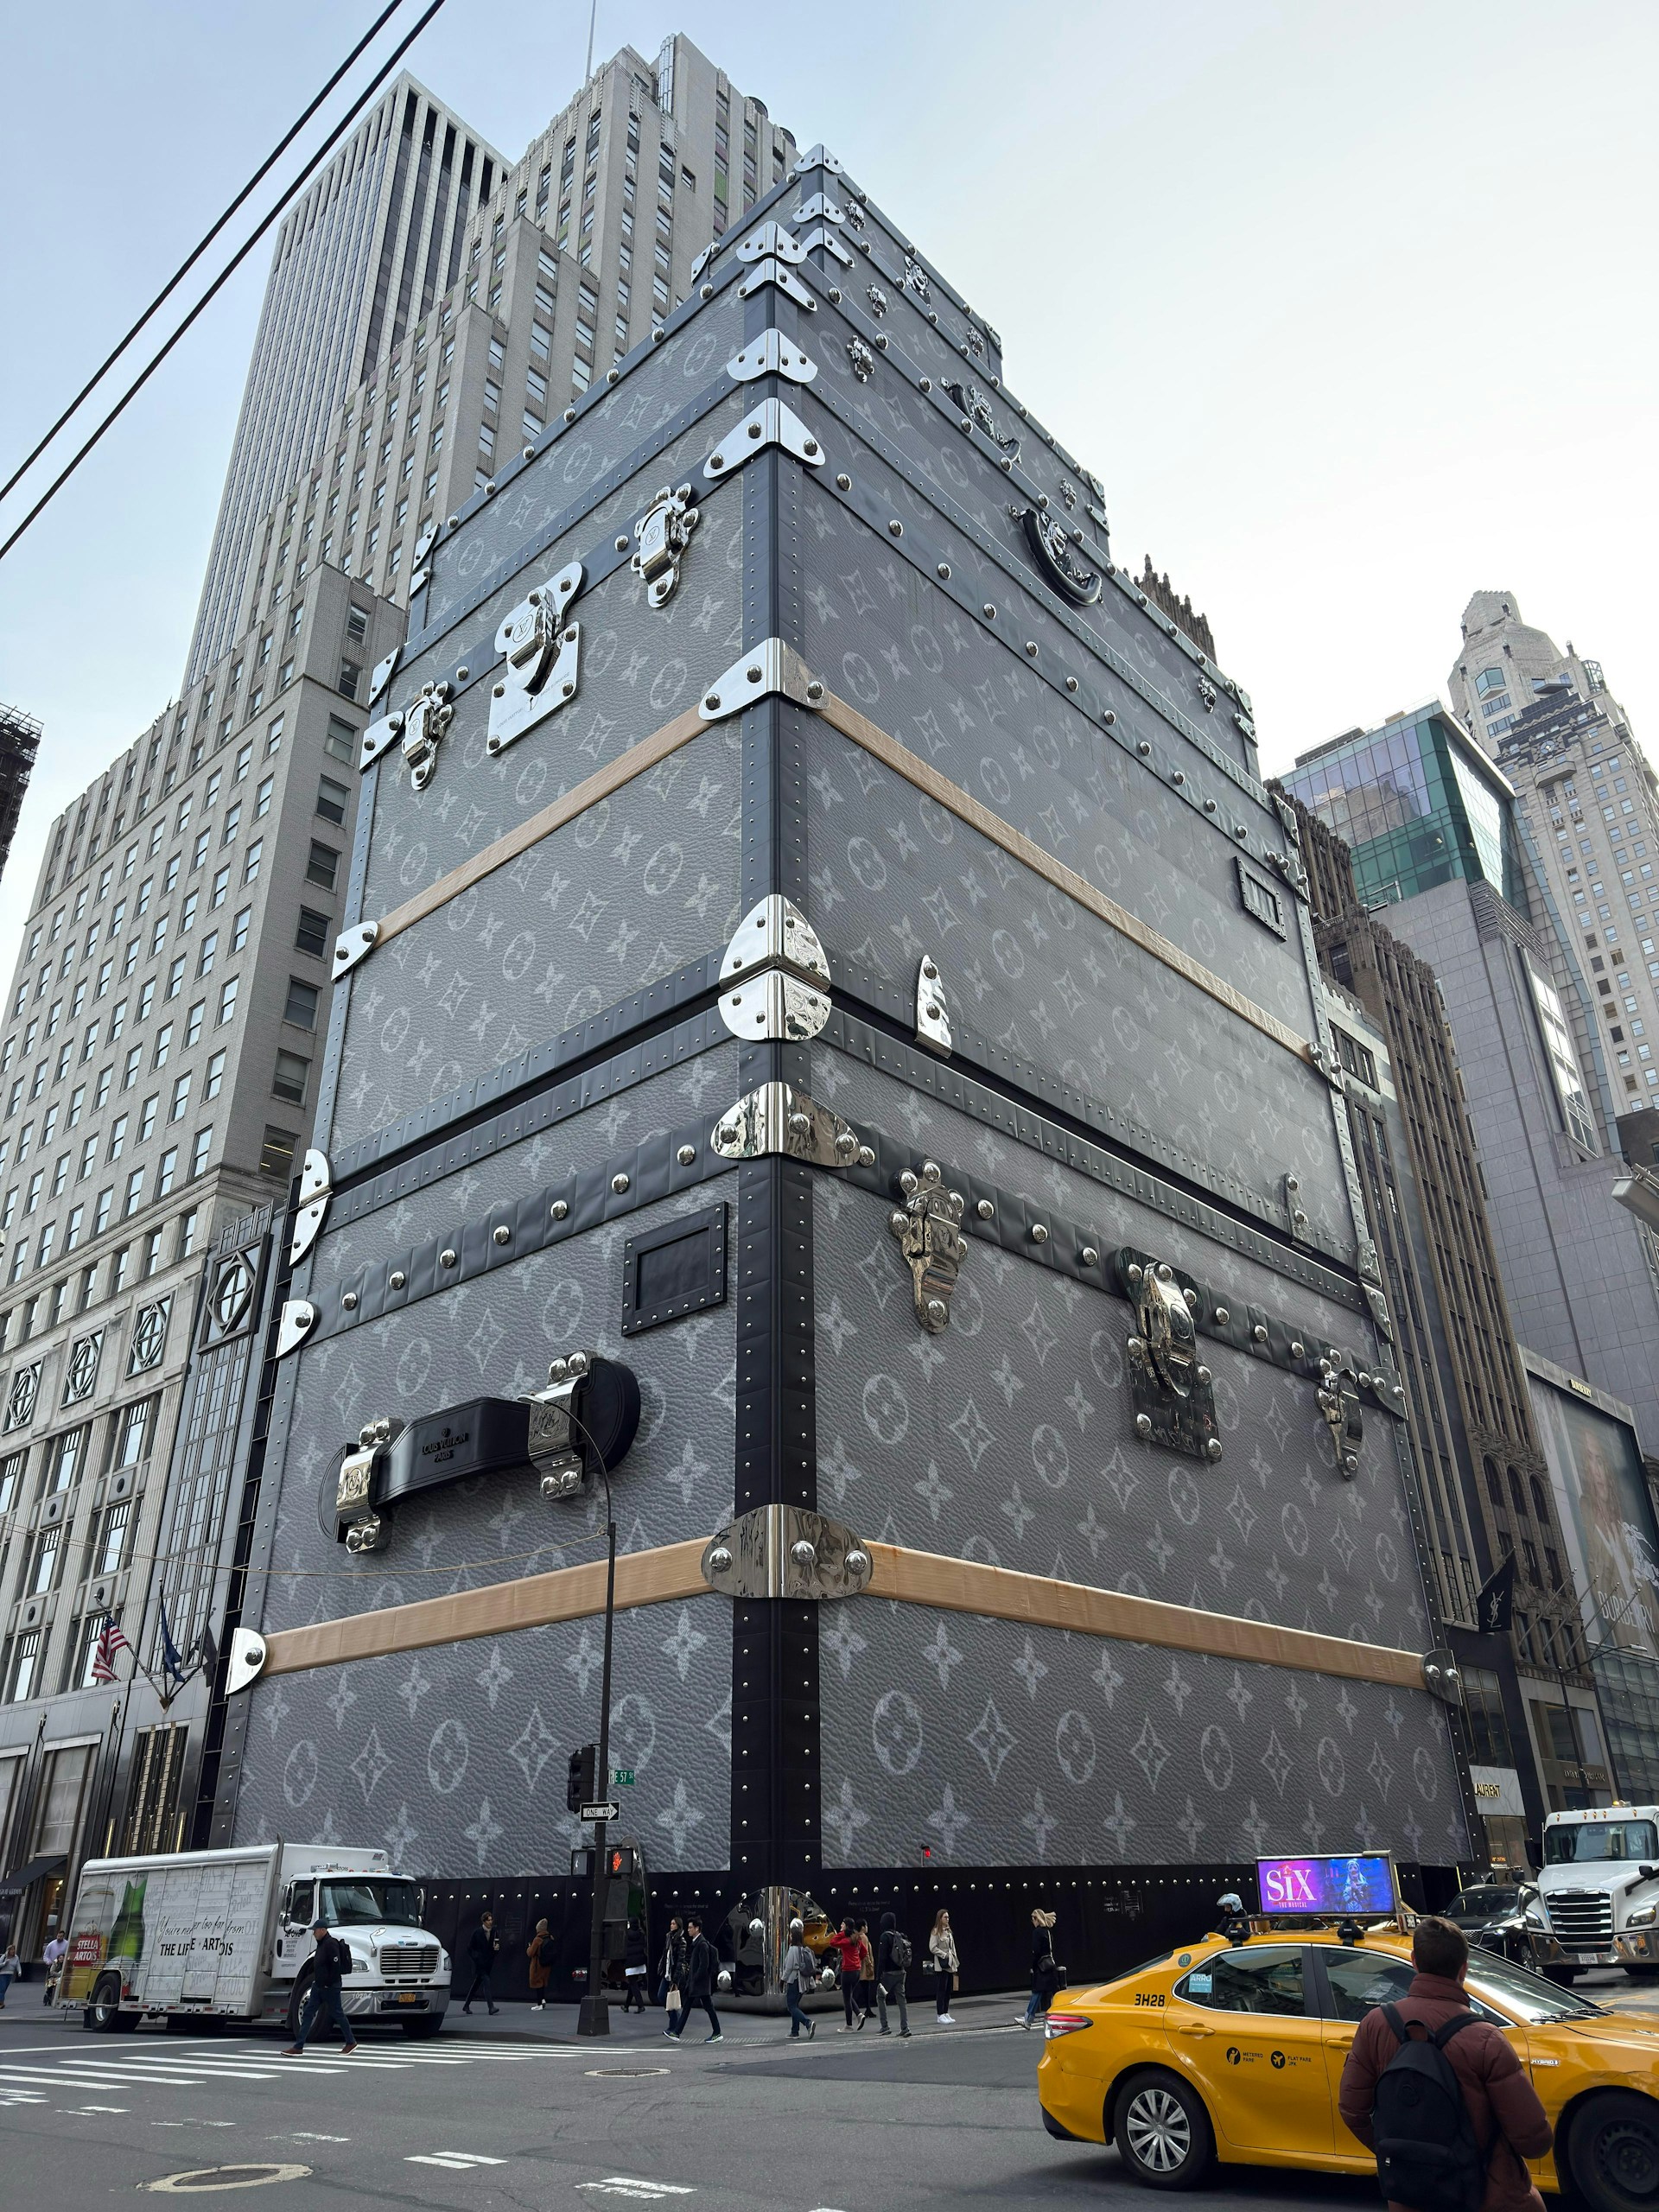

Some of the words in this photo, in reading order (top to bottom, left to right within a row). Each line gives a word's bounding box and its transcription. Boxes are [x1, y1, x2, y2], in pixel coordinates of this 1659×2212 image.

[440, 1433, 468, 1449] VUITTON
[620, 1771, 627, 1783] 57
[1475, 1783, 1500, 1798] LAURENT
[602, 1808, 614, 1816] WAY
[201, 1915, 213, 1929] too
[212, 1915, 225, 1936] far
[223, 1920, 245, 1940] from
[77, 1940, 99, 1950] STELLA
[161, 1943, 176, 1956] THE
[176, 1937, 196, 1956] LIFE
[201, 1937, 234, 1956] ARTOIS
[73, 1951, 98, 1961] ARTOIS
